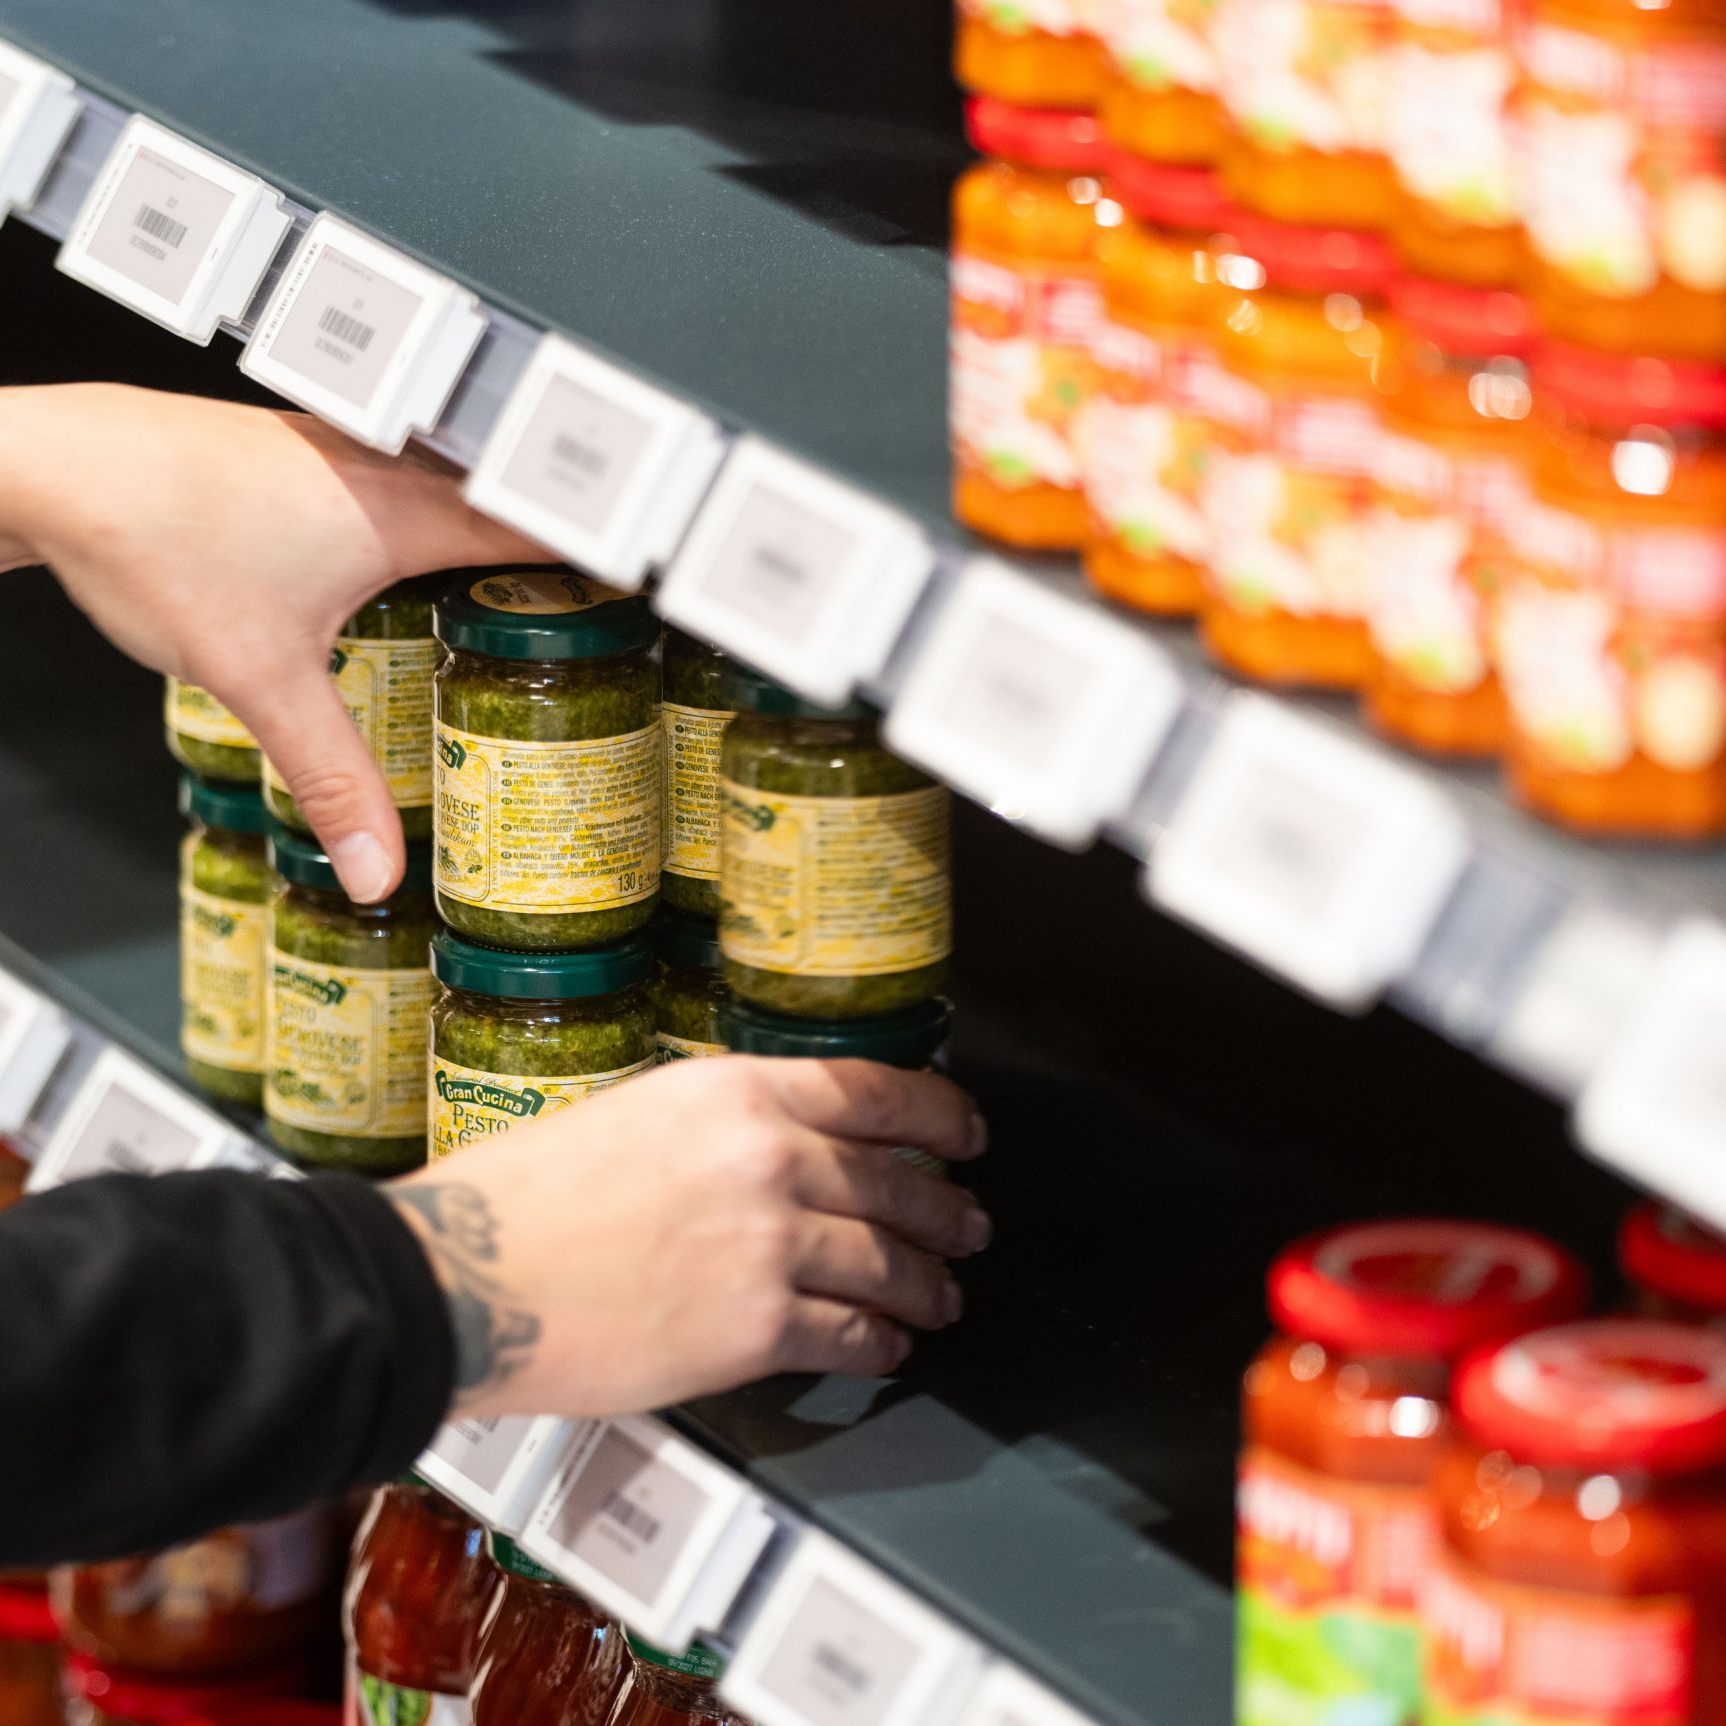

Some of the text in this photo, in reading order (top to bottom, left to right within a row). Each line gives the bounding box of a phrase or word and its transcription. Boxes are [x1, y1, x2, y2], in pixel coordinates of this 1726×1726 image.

[684, 725, 698, 736] PESTO
[698, 728, 708, 737] ALLA
[685, 744, 698, 753] PESTO
[698, 746, 704, 755] DE
[513, 761, 528, 769] PESTO
[685, 762, 709, 774] GENOVESE
[513, 779, 528, 787] PESTO
[529, 780, 536, 788] DE
[685, 789, 699, 799] PESTO
[700, 792, 713, 800] NACH
[440, 791, 480, 821] OVESE
[513, 798, 540, 806] GENOVESE
[543, 798, 561, 806] PESTO
[519, 817, 533, 825] other
[534, 817, 546, 825] nuts
[547, 817, 557, 825] and
[685, 817, 711, 828] ALBAHACA
[462, 820, 480, 836] DOP
[513, 824, 529, 832] PESTO
[530, 825, 544, 833] NACH
[512, 852, 542, 860] ALBAHACA
[549, 853, 568, 861] QUESO
[570, 850, 591, 860] MOLIDO
[598, 849, 605, 858] LA
[532, 871, 549, 880] Puede
[618, 871, 636, 892] 130
[638, 874, 644, 891] g
[452, 1103, 509, 1134] PESTO
[433, 1122, 453, 1148] LLA
